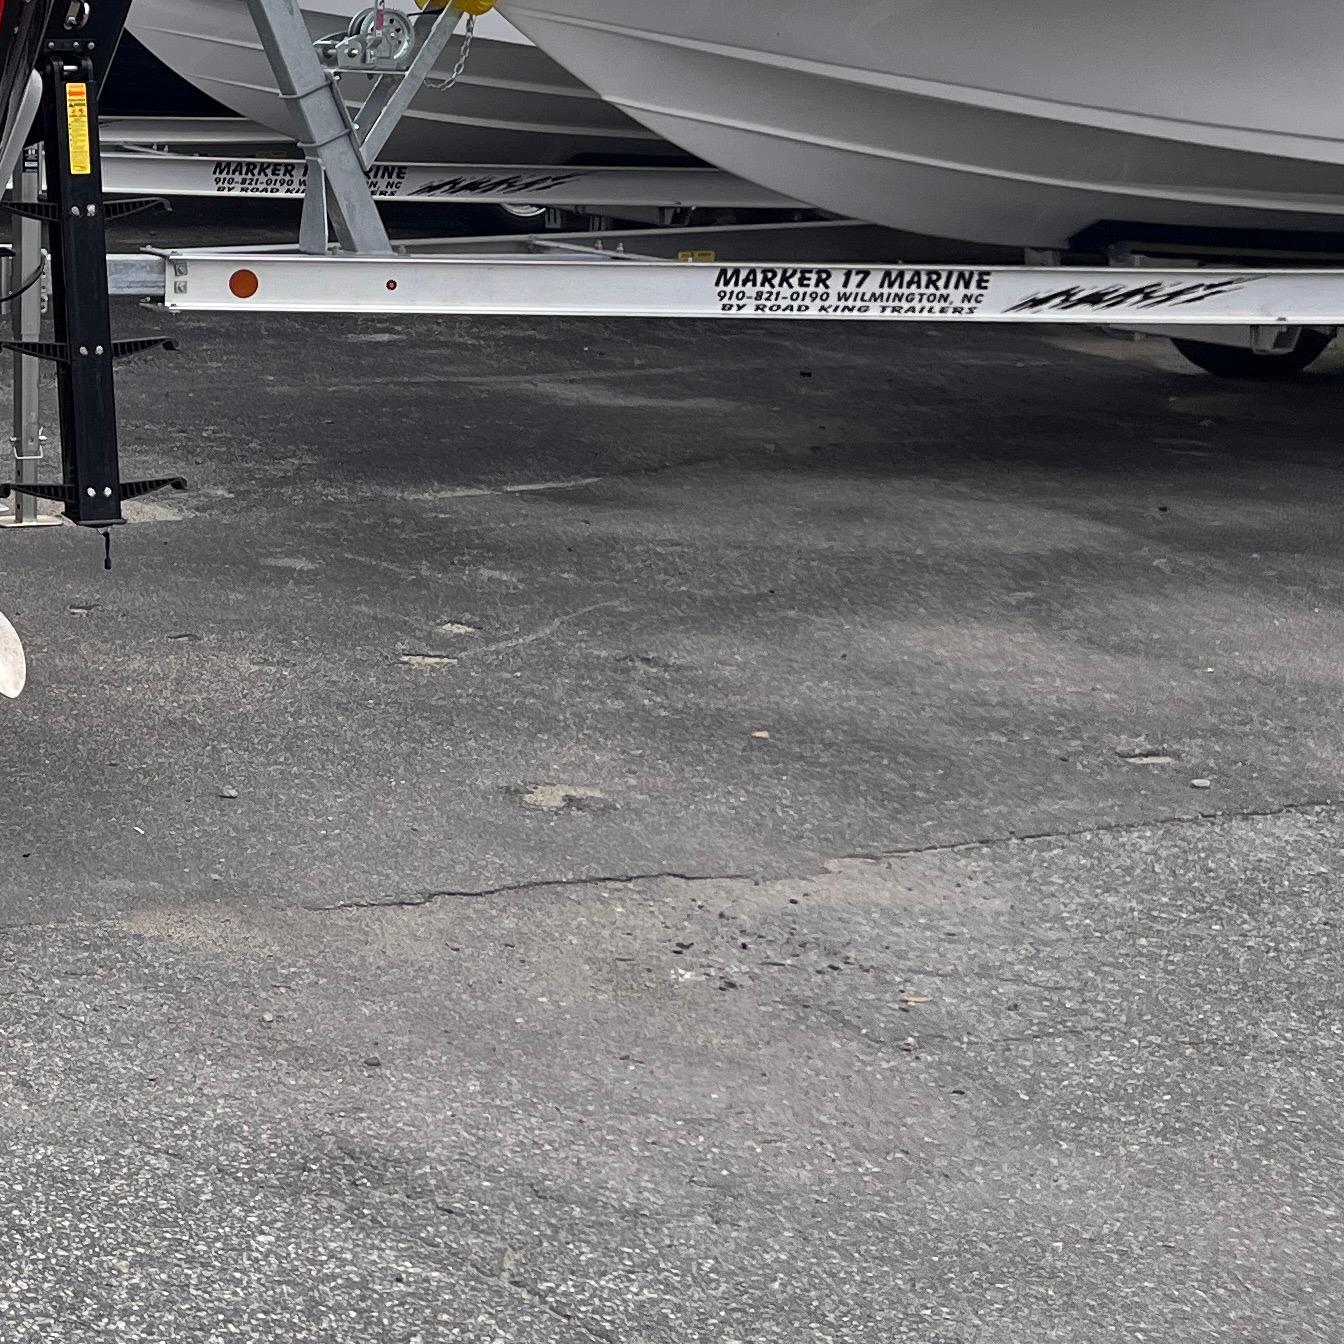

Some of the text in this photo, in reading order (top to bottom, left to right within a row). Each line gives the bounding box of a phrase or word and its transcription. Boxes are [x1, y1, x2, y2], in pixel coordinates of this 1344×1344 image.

[212, 162, 297, 178] MARKER
[364, 165, 408, 180] RINE
[214, 177, 294, 187] 910-821-0190
[386, 181, 402, 189] NC
[239, 186, 280, 194] ROAD
[714, 267, 992, 290] MARKER 17 MARINE
[717, 290, 985, 306] 910-821-0190 WILMINGTON, NC
[720, 303, 979, 315] BY ROAD KING TRAILERS
